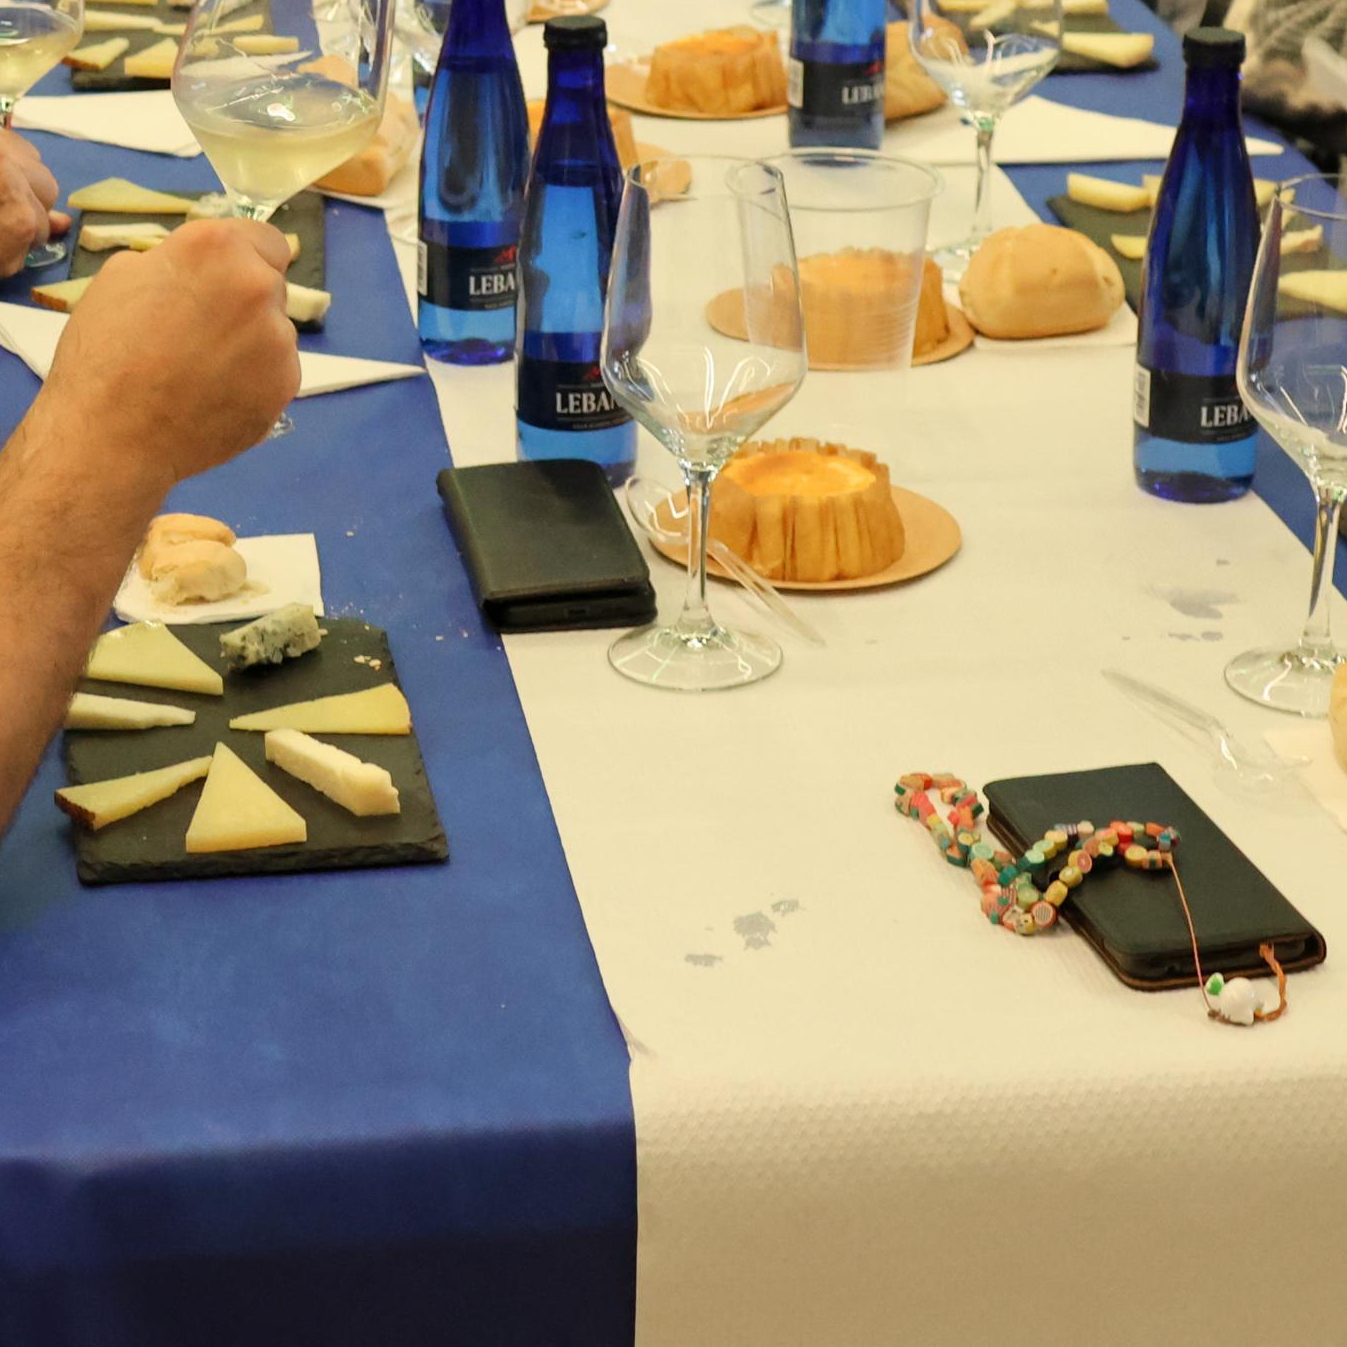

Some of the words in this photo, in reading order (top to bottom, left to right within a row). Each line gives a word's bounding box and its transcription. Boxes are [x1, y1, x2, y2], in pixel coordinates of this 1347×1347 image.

[469, 271, 516, 296] LEBA
[555, 391, 616, 414] LEBA
[1200, 404, 1250, 428] LEBA
